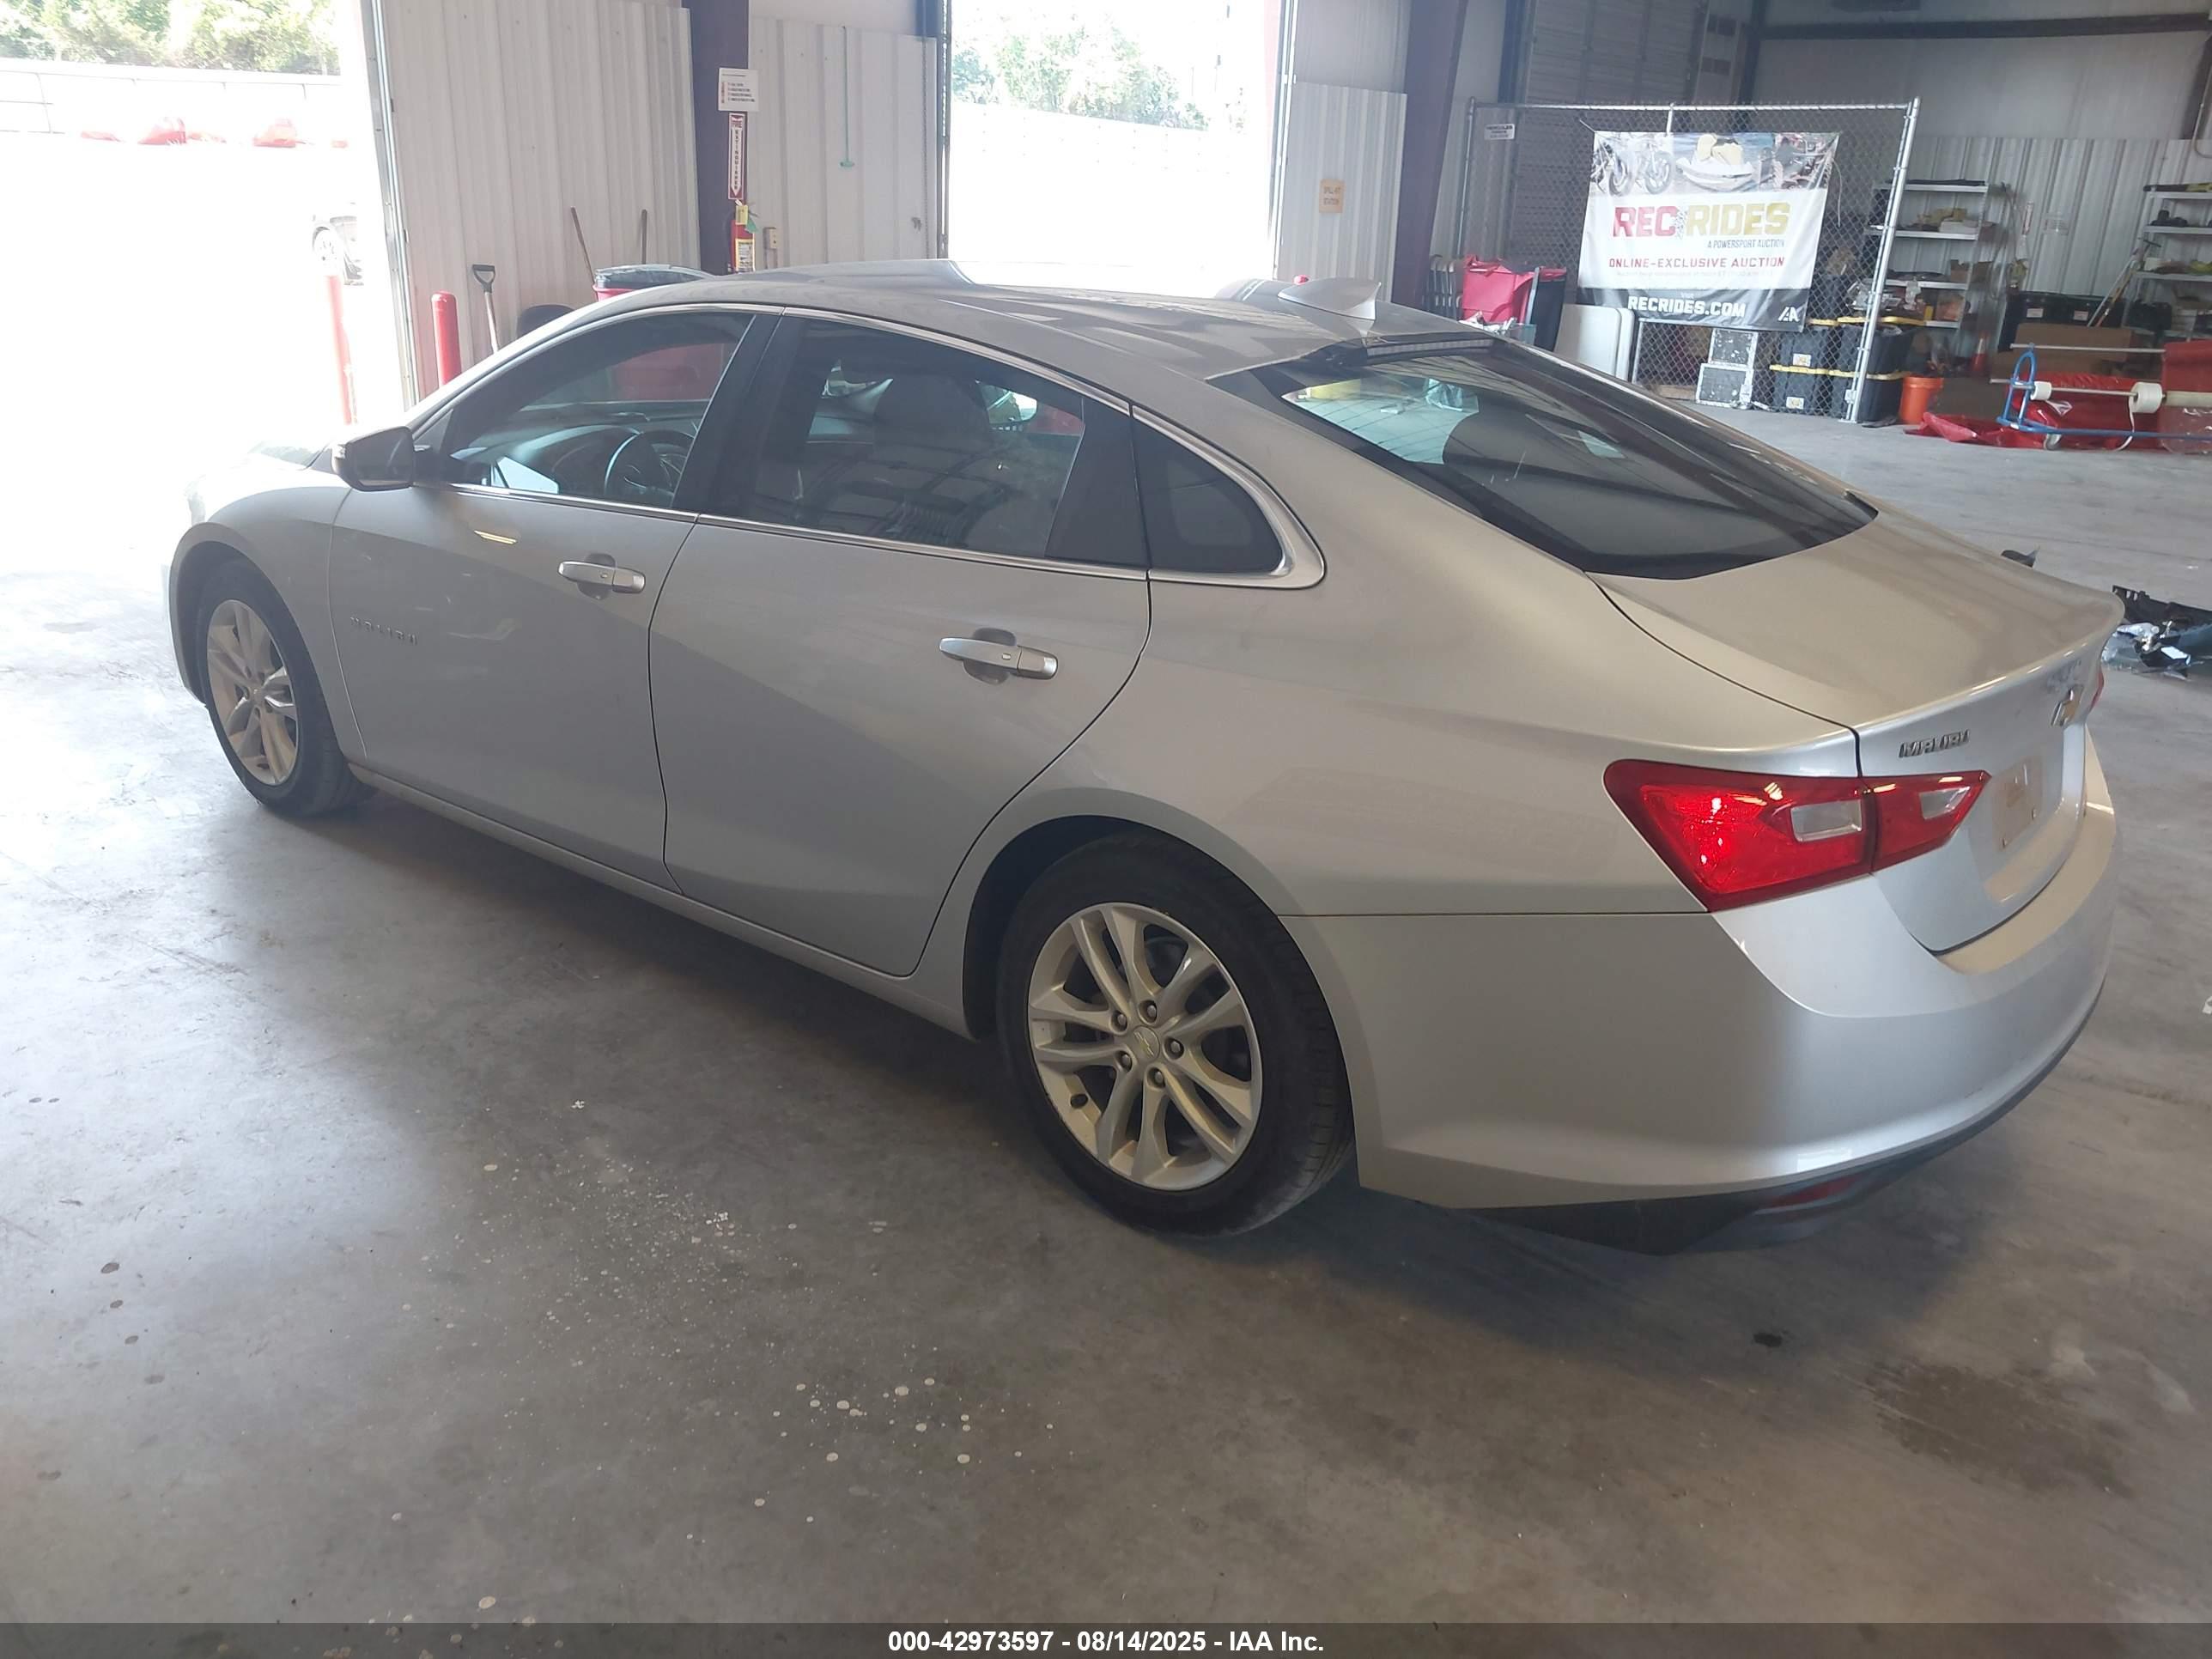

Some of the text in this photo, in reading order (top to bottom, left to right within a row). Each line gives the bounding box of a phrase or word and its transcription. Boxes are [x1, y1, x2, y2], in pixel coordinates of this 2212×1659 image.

[1613, 203, 1790, 237] REC RIDES
[1713, 240, 1755, 248] POWERSPORT
[1757, 239, 1785, 247] AUCTION
[1609, 257, 1784, 268] ONLINE-EXCLUSIVE AUCTION
[1628, 296, 1747, 318] RECRIDES.COM
[1898, 729, 1970, 758] MALIBU
